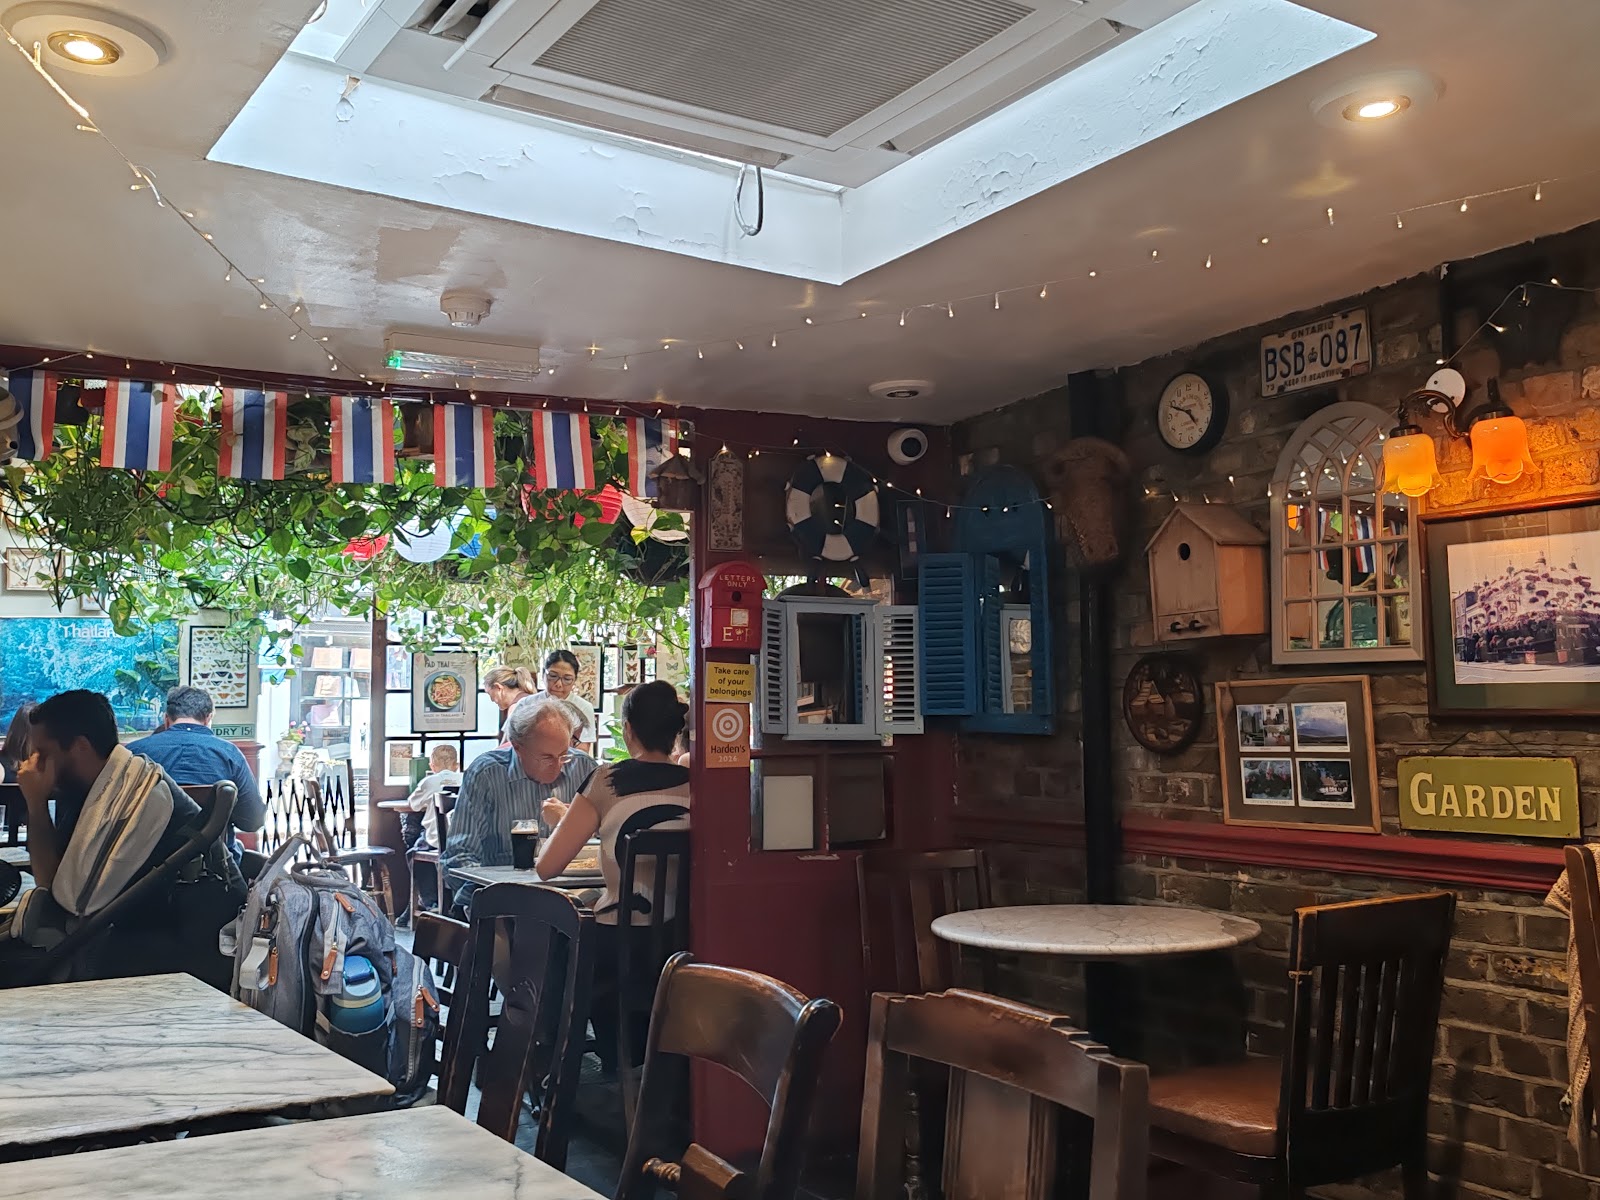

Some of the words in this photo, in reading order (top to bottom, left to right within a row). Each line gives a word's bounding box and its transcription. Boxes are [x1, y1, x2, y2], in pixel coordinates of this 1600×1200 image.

[1291, 320, 1334, 340] ONTARIO
[1264, 341, 1305, 383] BSB
[1320, 322, 1362, 368] 087
[1284, 377, 1299, 387] KEEP
[1301, 375, 1307, 383] IT
[719, 574, 756, 583] LETTERS
[727, 580, 748, 588] ONLY
[58, 621, 122, 638] Thailan
[713, 666, 731, 675] Take
[709, 687, 752, 697] belongings
[710, 744, 746, 754] Harden's
[718, 755, 738, 763] 2026
